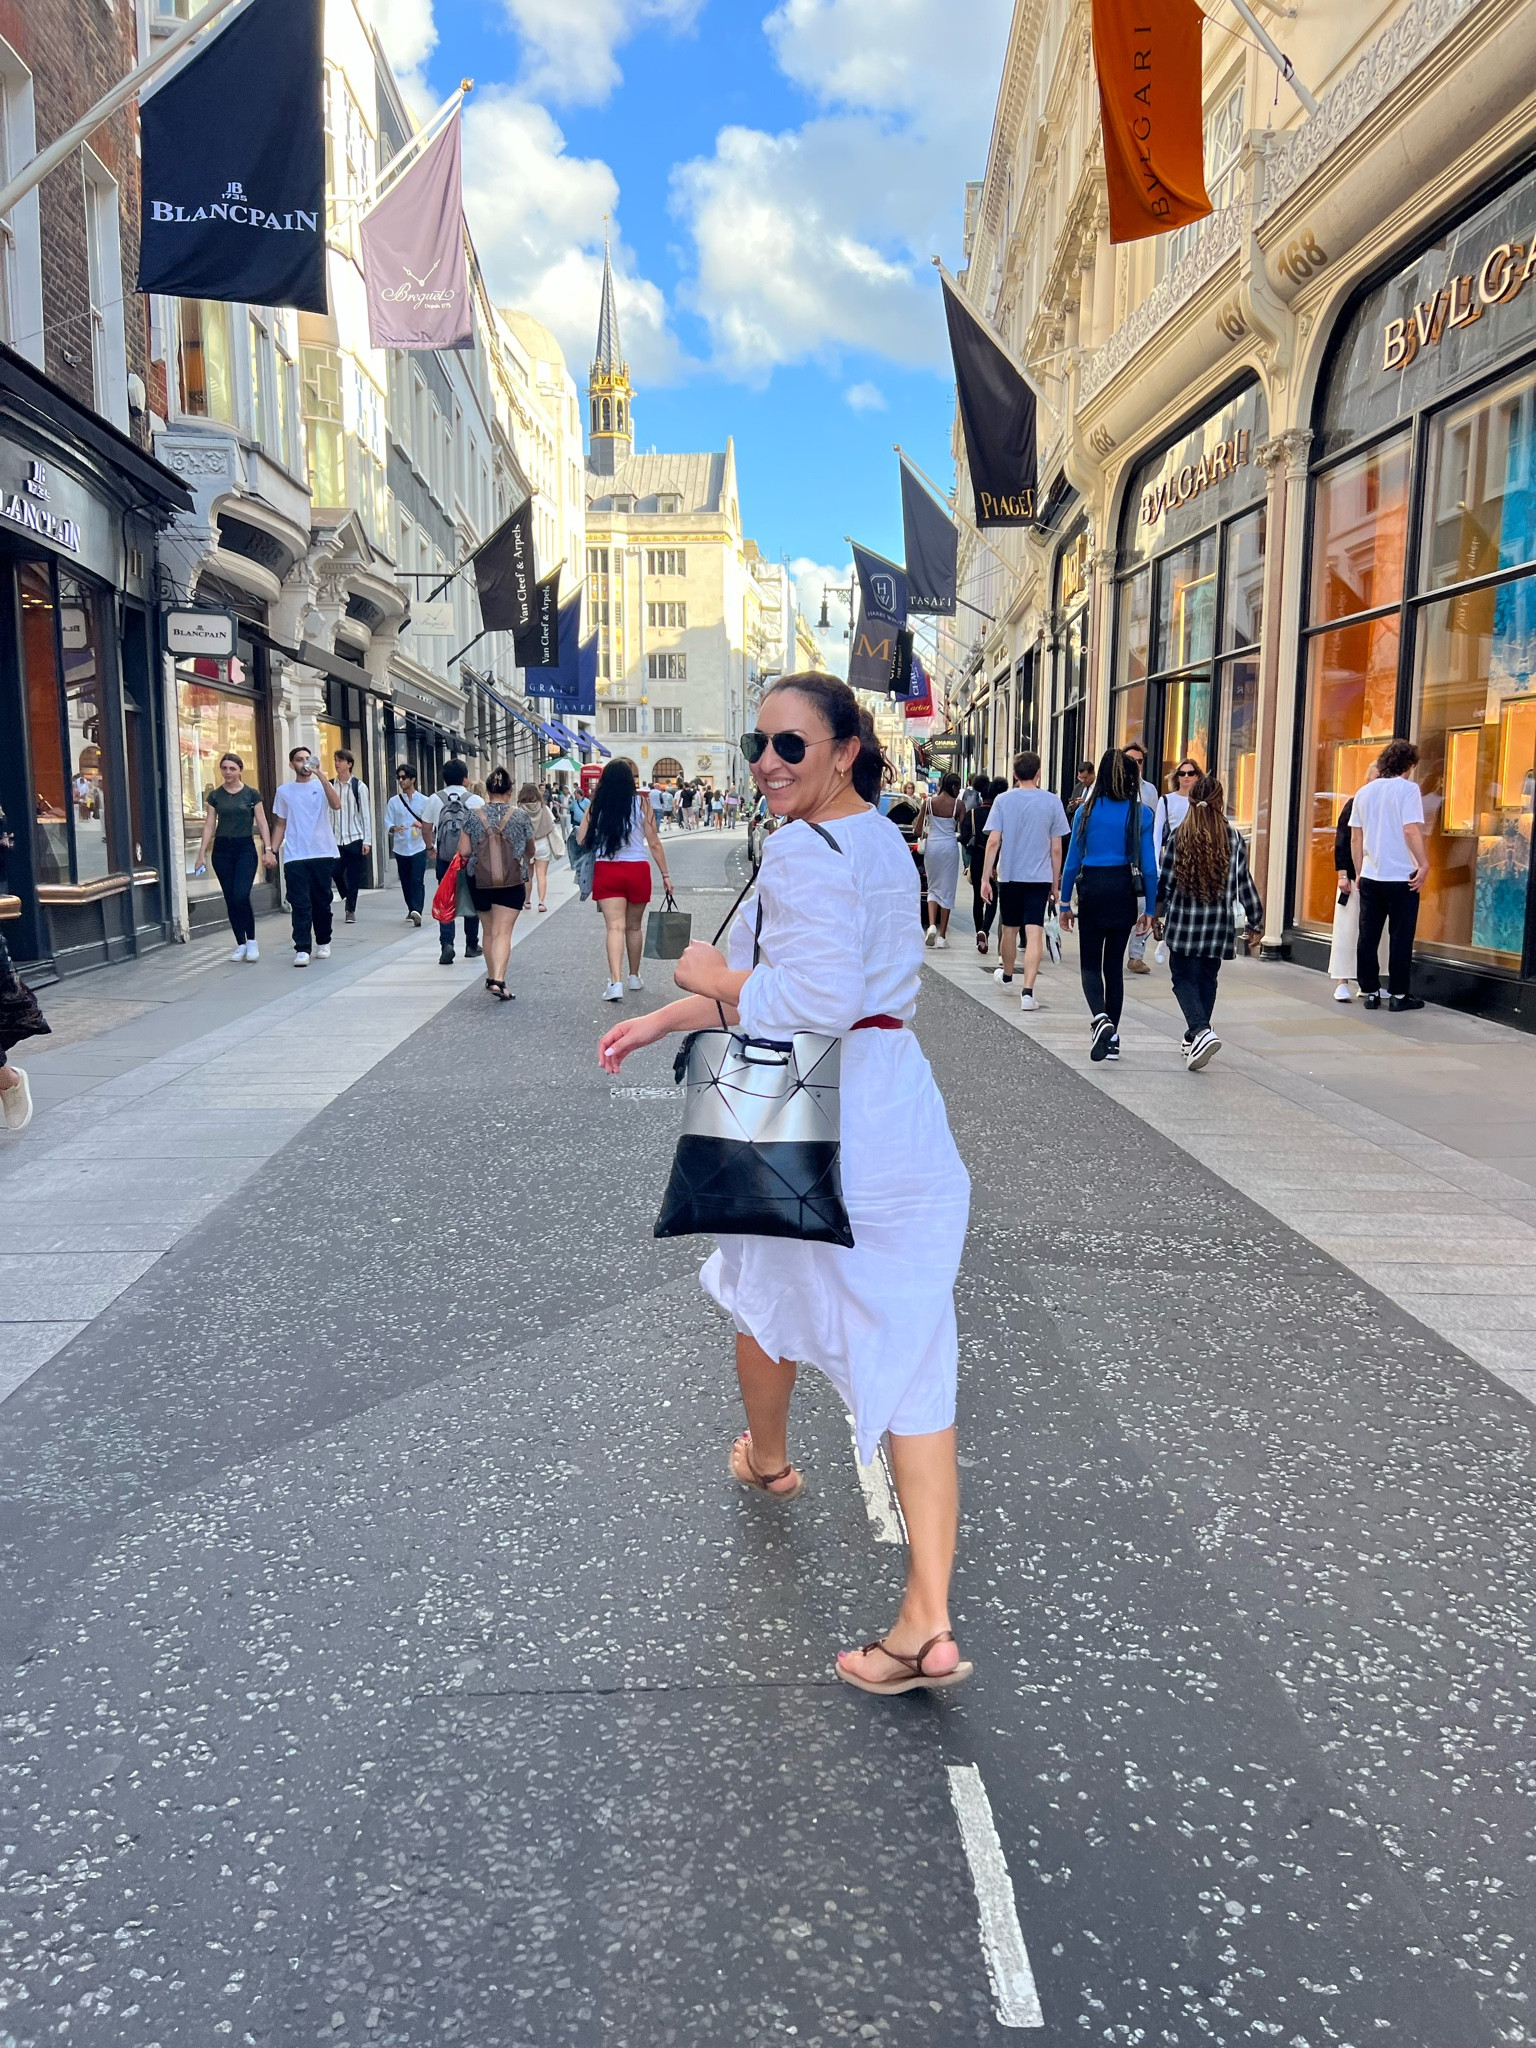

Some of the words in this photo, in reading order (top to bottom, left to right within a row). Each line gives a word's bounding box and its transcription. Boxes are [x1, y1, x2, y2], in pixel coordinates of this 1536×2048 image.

[1133, 27, 1170, 217] BVLGARI
[221, 193, 248, 202] 1735
[151, 200, 319, 232] BLANCPAIN
[1277, 227, 1328, 286] 168
[381, 282, 455, 310] Breguet
[1090, 423, 1117, 456] 168
[1140, 429, 1249, 526] BVLGARI
[980, 488, 1035, 519] PIAGET
[511, 523, 525, 559] Arpels
[516, 561, 524, 570] &
[514, 572, 528, 603] Cleef
[541, 585, 552, 612] Arpels
[909, 595, 952, 607] TASAKI
[520, 603, 529, 625] Van
[173, 628, 227, 639] BLANCPAIN
[541, 622, 550, 646] Cleef
[854, 633, 892, 662] M
[541, 646, 550, 664] Van
[906, 703, 931, 712] Cartier
